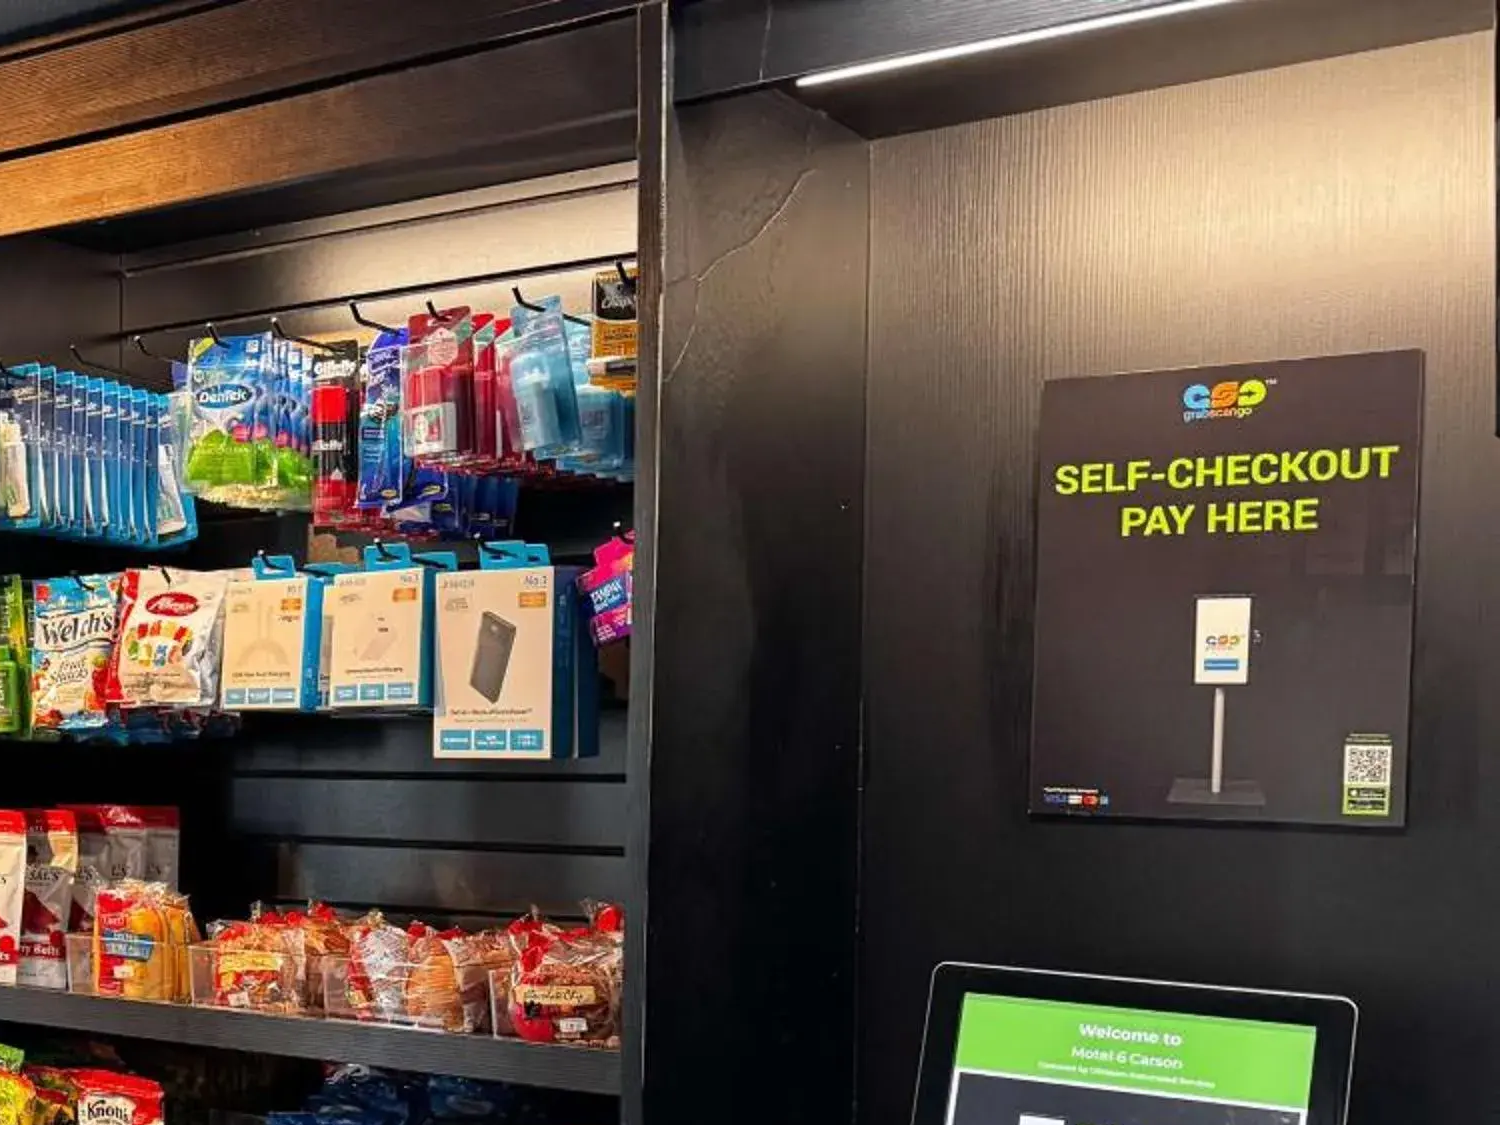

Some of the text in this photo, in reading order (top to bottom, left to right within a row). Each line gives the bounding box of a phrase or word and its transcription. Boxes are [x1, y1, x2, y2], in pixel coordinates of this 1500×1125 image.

[1054, 446, 1399, 495] SELF-CHECKOUT
[1120, 499, 1319, 536] PAY HERE
[40, 609, 113, 645] Welch's
[1079, 1024, 1182, 1047] Welcome to
[1071, 1047, 1184, 1070] Motel 6 Carson
